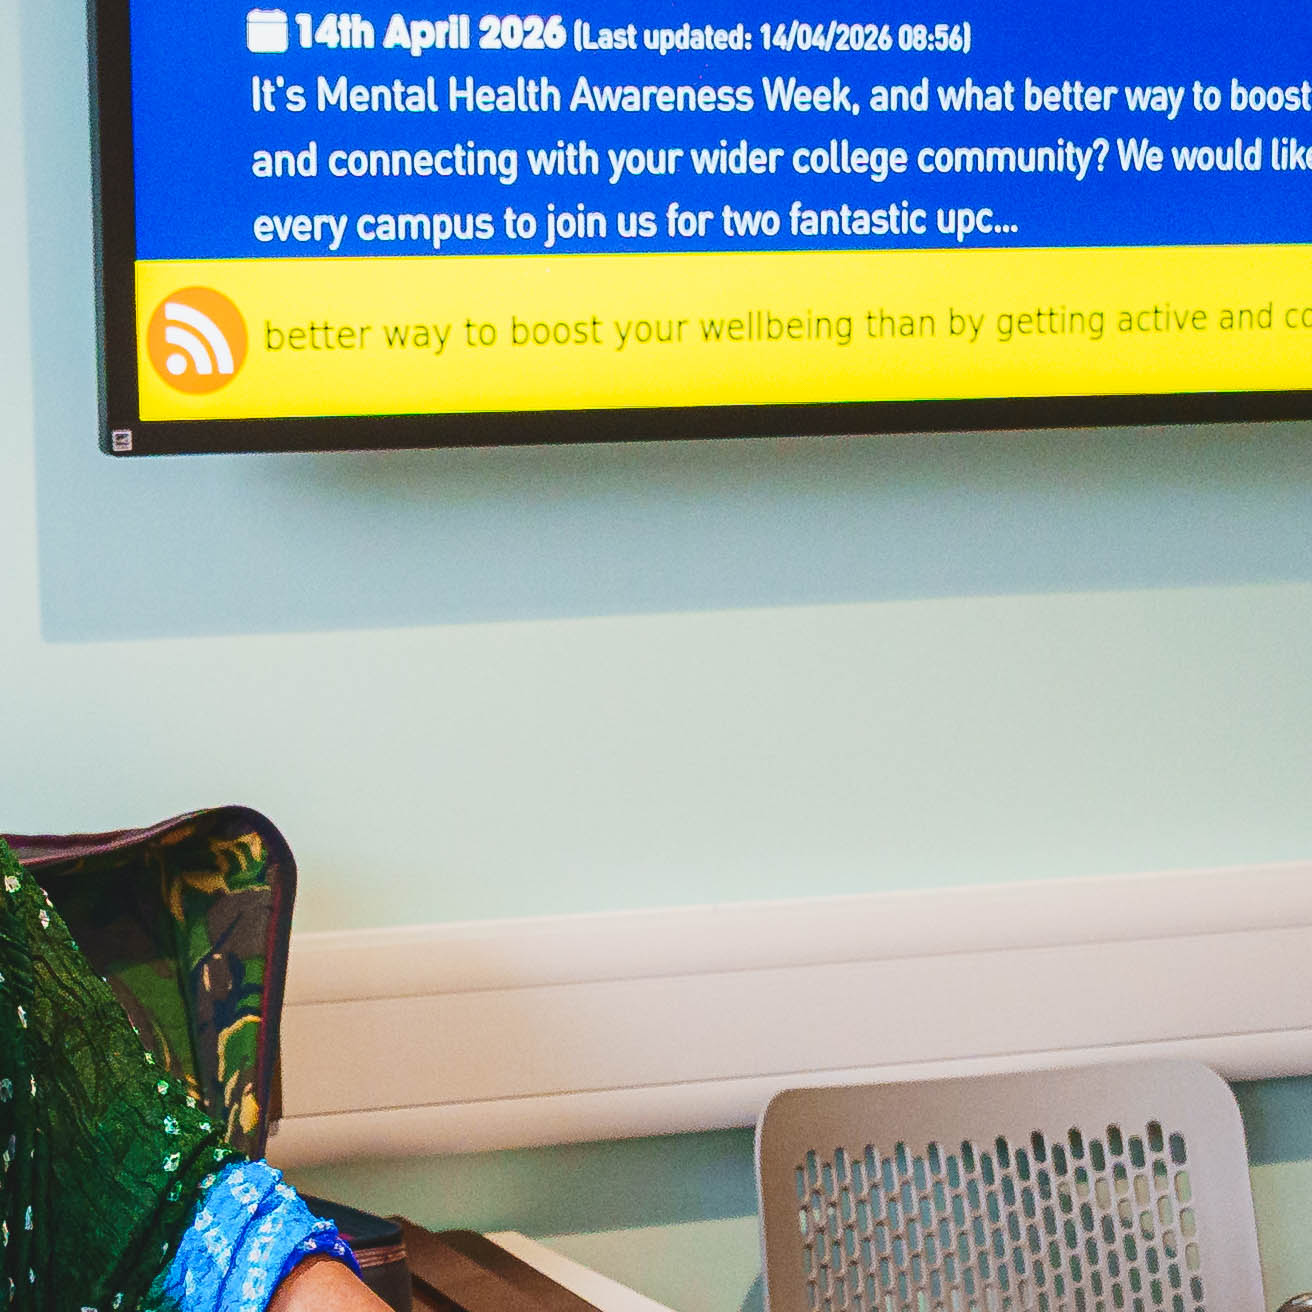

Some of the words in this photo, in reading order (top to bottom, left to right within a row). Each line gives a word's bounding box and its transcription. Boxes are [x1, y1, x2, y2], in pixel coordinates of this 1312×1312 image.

[295, 13, 374, 48] 14th
[383, 14, 469, 56] April
[479, 15, 566, 49] 2026
[574, 19, 637, 51] (Last
[644, 23, 752, 55] updated:
[760, 20, 893, 51] 14/04/2026
[899, 22, 971, 53] 08:56)
[253, 76, 306, 111] It's
[318, 76, 438, 111] Mental
[449, 76, 560, 111] Health
[570, 76, 754, 111] Awareness
[762, 77, 859, 115] Week,
[870, 78, 928, 111] and
[937, 78, 1014, 111] what
[1025, 78, 1118, 111] better
[1125, 86, 1184, 120] way
[1193, 81, 1221, 111] to
[1231, 79, 1311, 111] boost
[252, 141, 317, 177] and
[329, 141, 517, 184] connecting
[527, 140, 598, 175] with
[608, 149, 683, 184] your
[691, 140, 784, 173] wider
[793, 140, 908, 182] college
[918, 138, 1109, 180] community?
[1117, 138, 1163, 171] We
[1172, 138, 1261, 170] would
[254, 215, 347, 250] every
[357, 214, 494, 249] campus
[504, 207, 536, 238] to
[544, 203, 606, 247] join
[618, 212, 657, 237] us
[666, 202, 714, 237] for
[722, 205, 780, 236] two
[790, 200, 926, 235] fantastic
[937, 208, 1019, 244] upc...
[267, 322, 370, 349] better
[384, 326, 450, 354] way
[466, 320, 495, 346] to
[512, 317, 600, 344] boost
[616, 321, 687, 350] your
[702, 312, 851, 345] wellbeing
[867, 310, 934, 337] than
[950, 308, 984, 342] by
[998, 308, 1103, 342] getting
[1119, 306, 1207, 331] active
[1220, 302, 1272, 329] and
